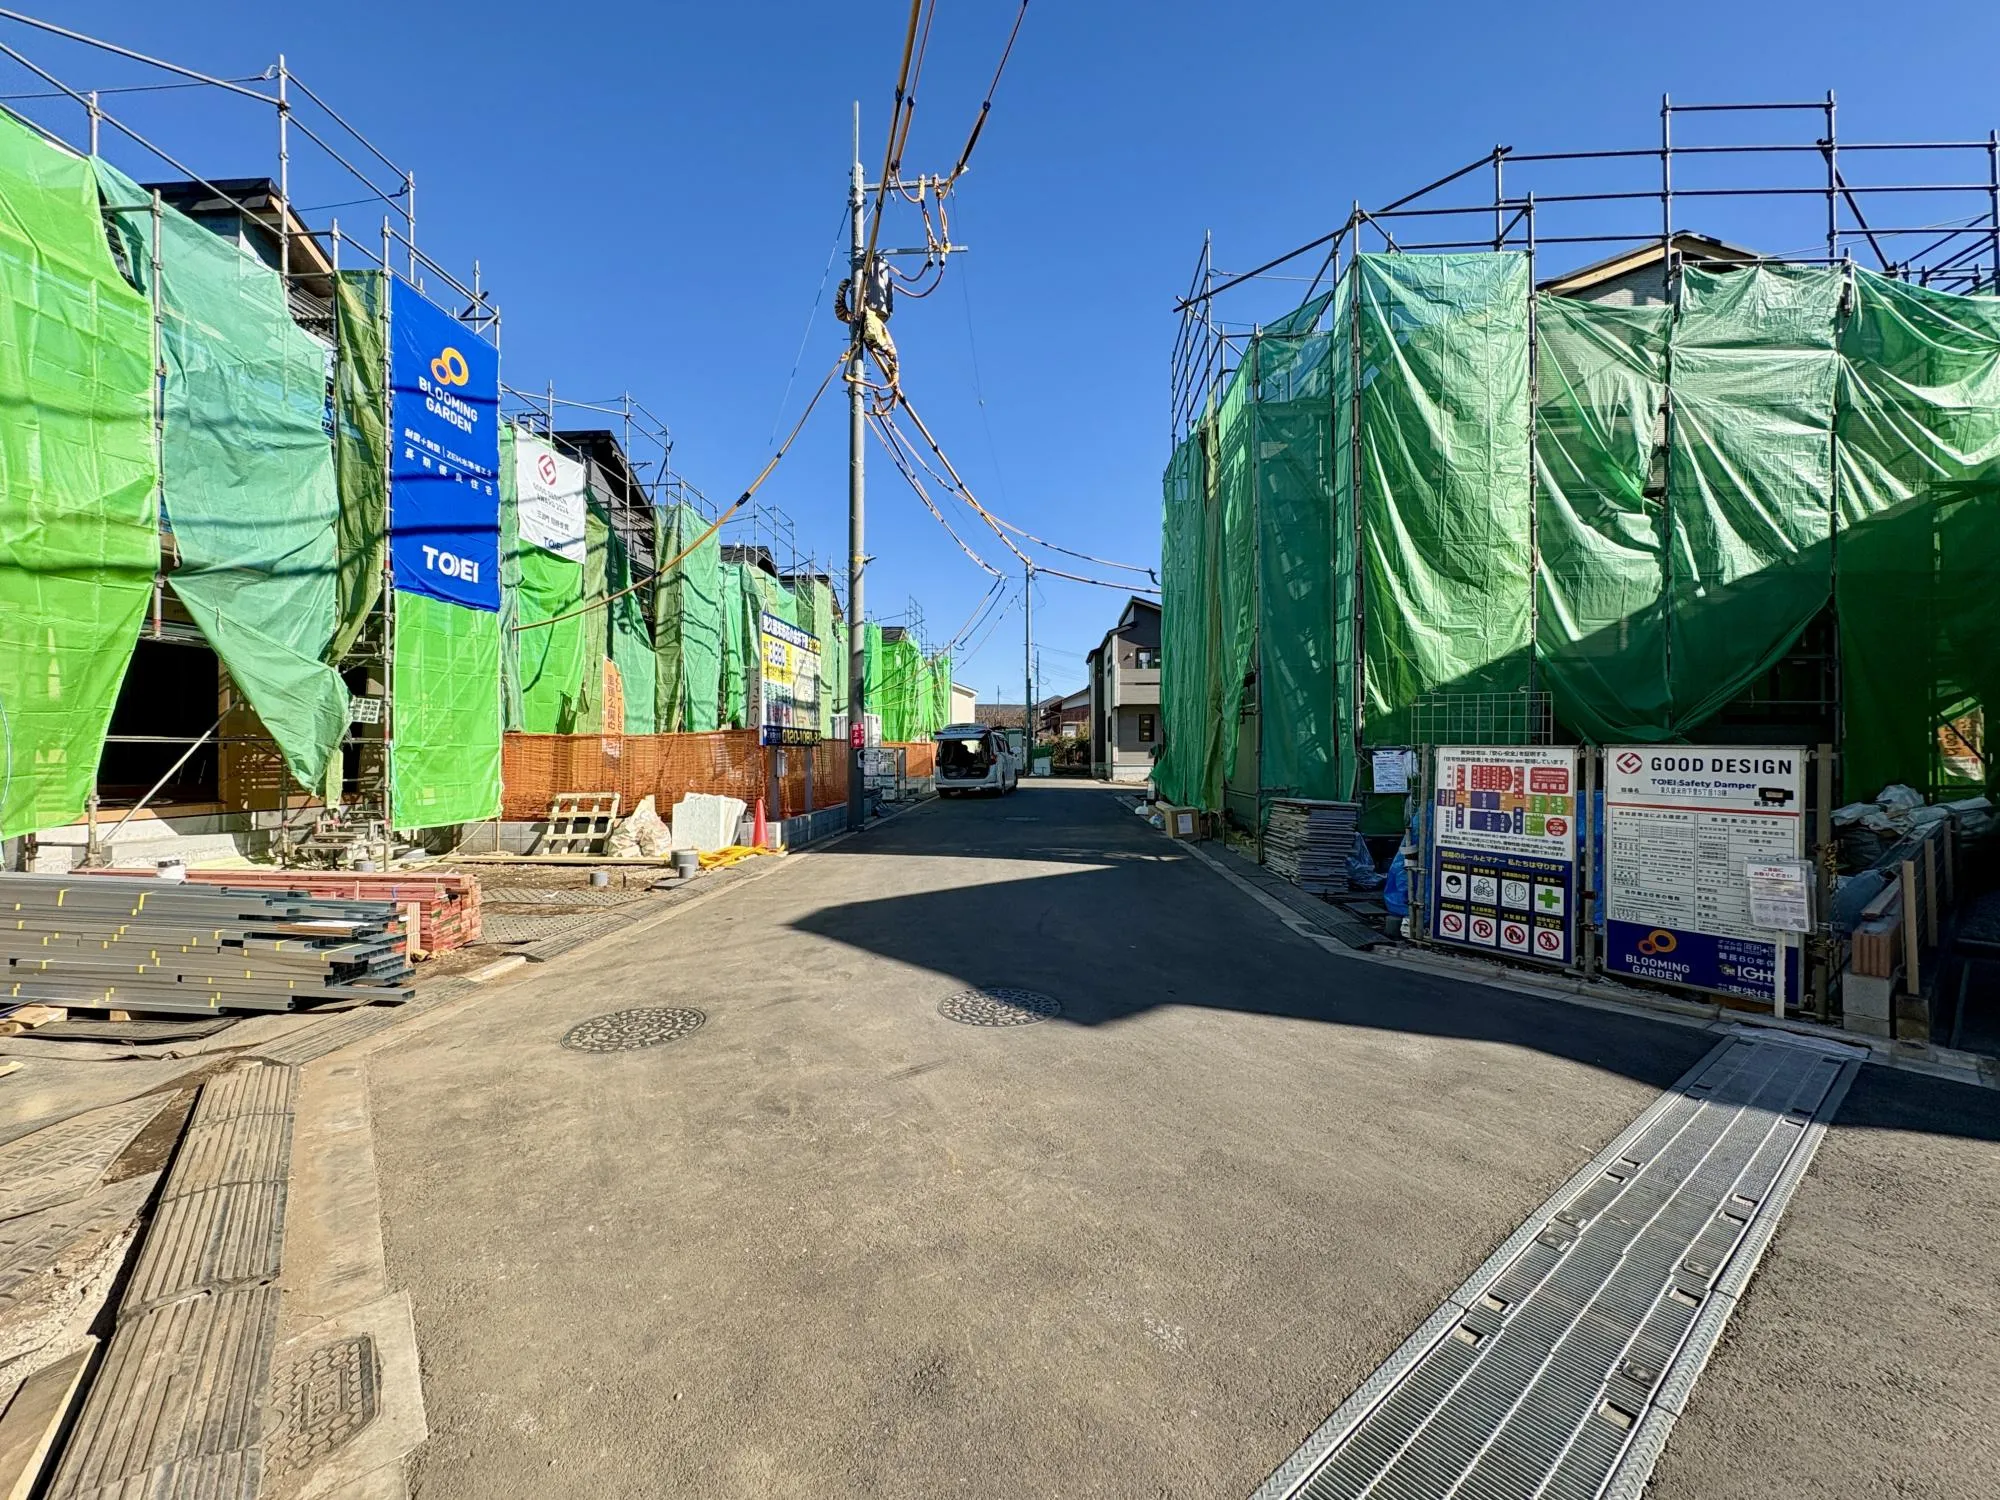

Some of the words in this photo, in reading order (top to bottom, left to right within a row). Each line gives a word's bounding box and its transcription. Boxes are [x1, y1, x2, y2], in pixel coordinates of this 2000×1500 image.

[418, 376, 478, 423] BLOOMING
[426, 396, 473, 434] GARDEN
[422, 544, 479, 583] TOEI
[1651, 757, 1704, 772] GOOD
[1711, 758, 1792, 775] DESIGN
[1679, 780, 1712, 789] Safety
[1714, 781, 1757, 790] Damper
[1508, 858, 1565, 872] 私たちは守ります
[1626, 954, 1690, 974] BLOOMING
[1632, 964, 1683, 982] GARDEN
[1728, 984, 1776, 999] 東栄住
